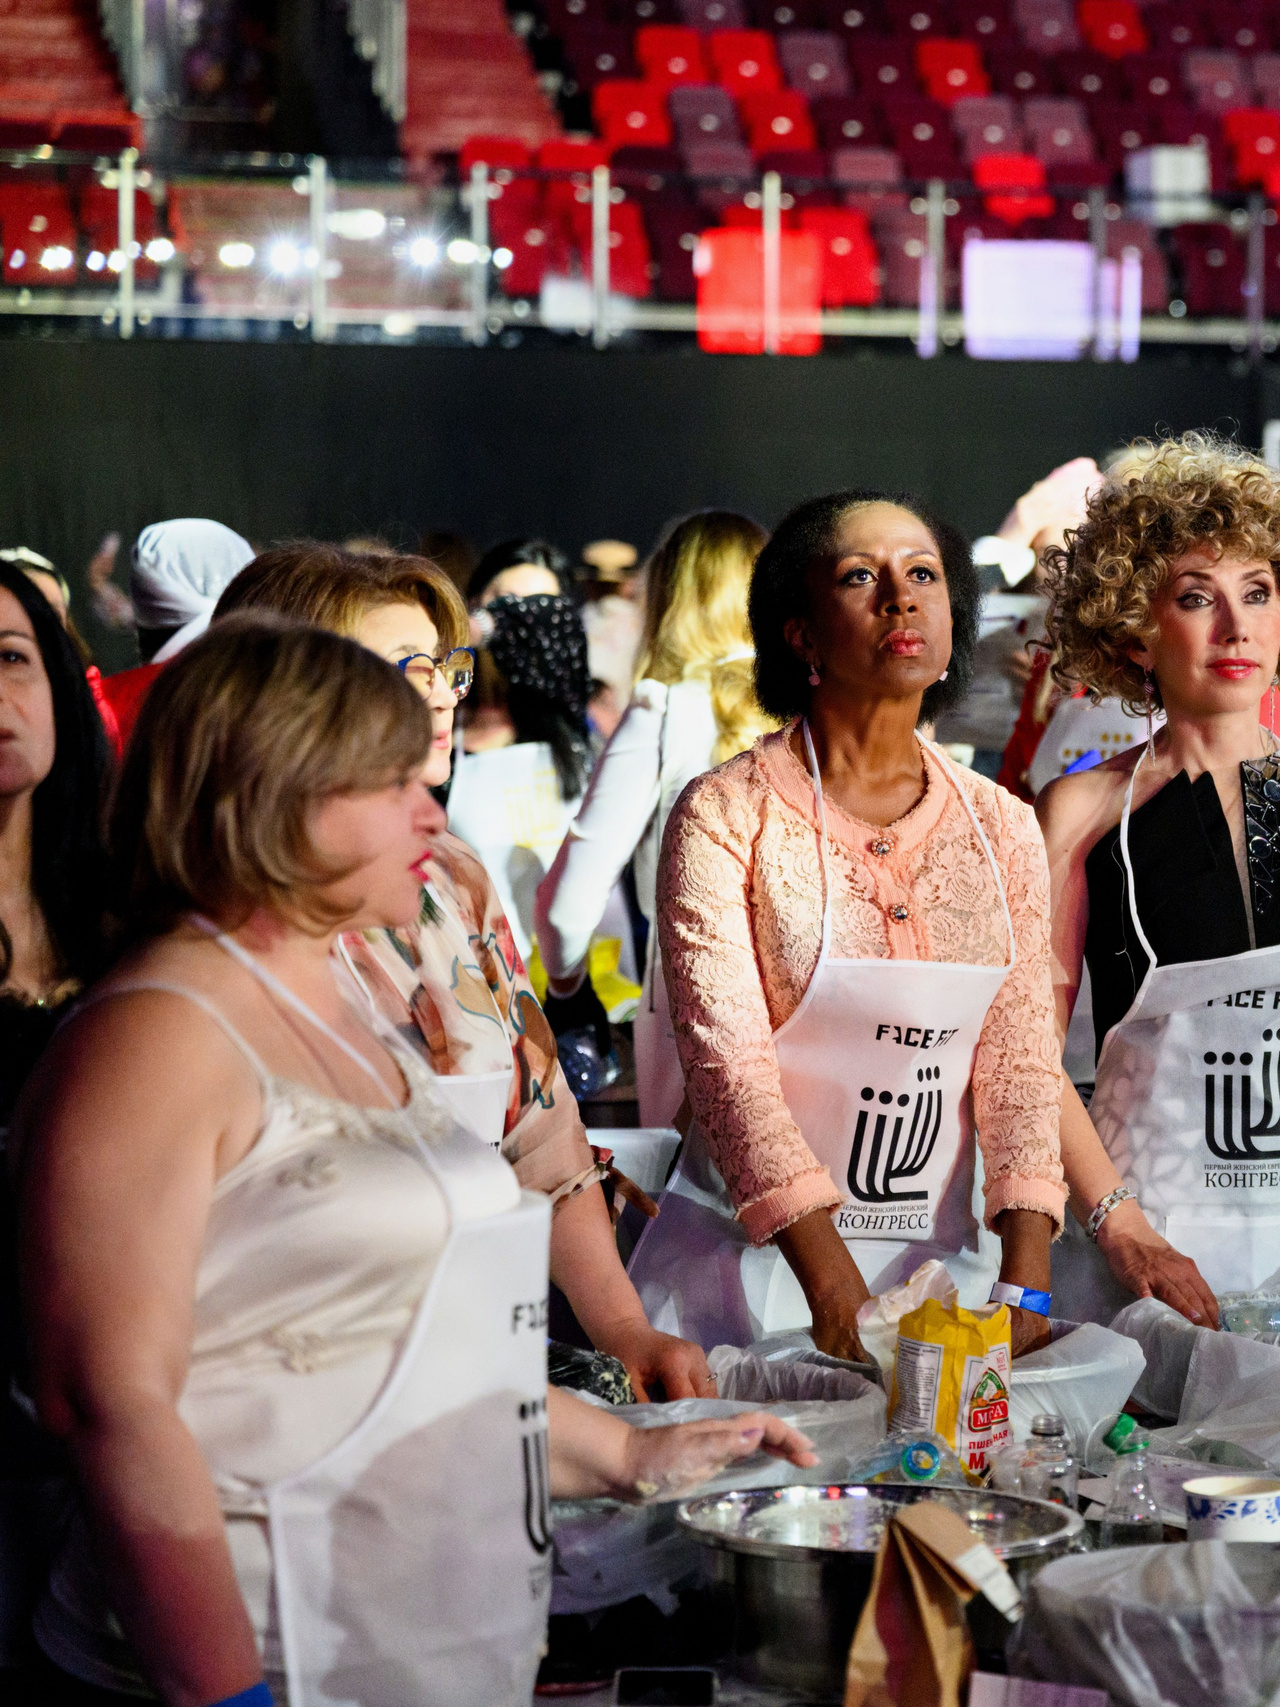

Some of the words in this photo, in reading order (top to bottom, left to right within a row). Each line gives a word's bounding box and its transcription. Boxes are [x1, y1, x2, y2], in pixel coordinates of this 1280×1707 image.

[1204, 1163, 1232, 1171] ПЕРВЫЙ
[1233, 1163, 1266, 1171] ЖЕНСКИЙ
[868, 1205, 896, 1213] ЖЕНСКИЙ
[897, 1203, 928, 1212] ЕВРЕЙСКИЙ
[837, 1212, 929, 1230] КОНГРЕСС
